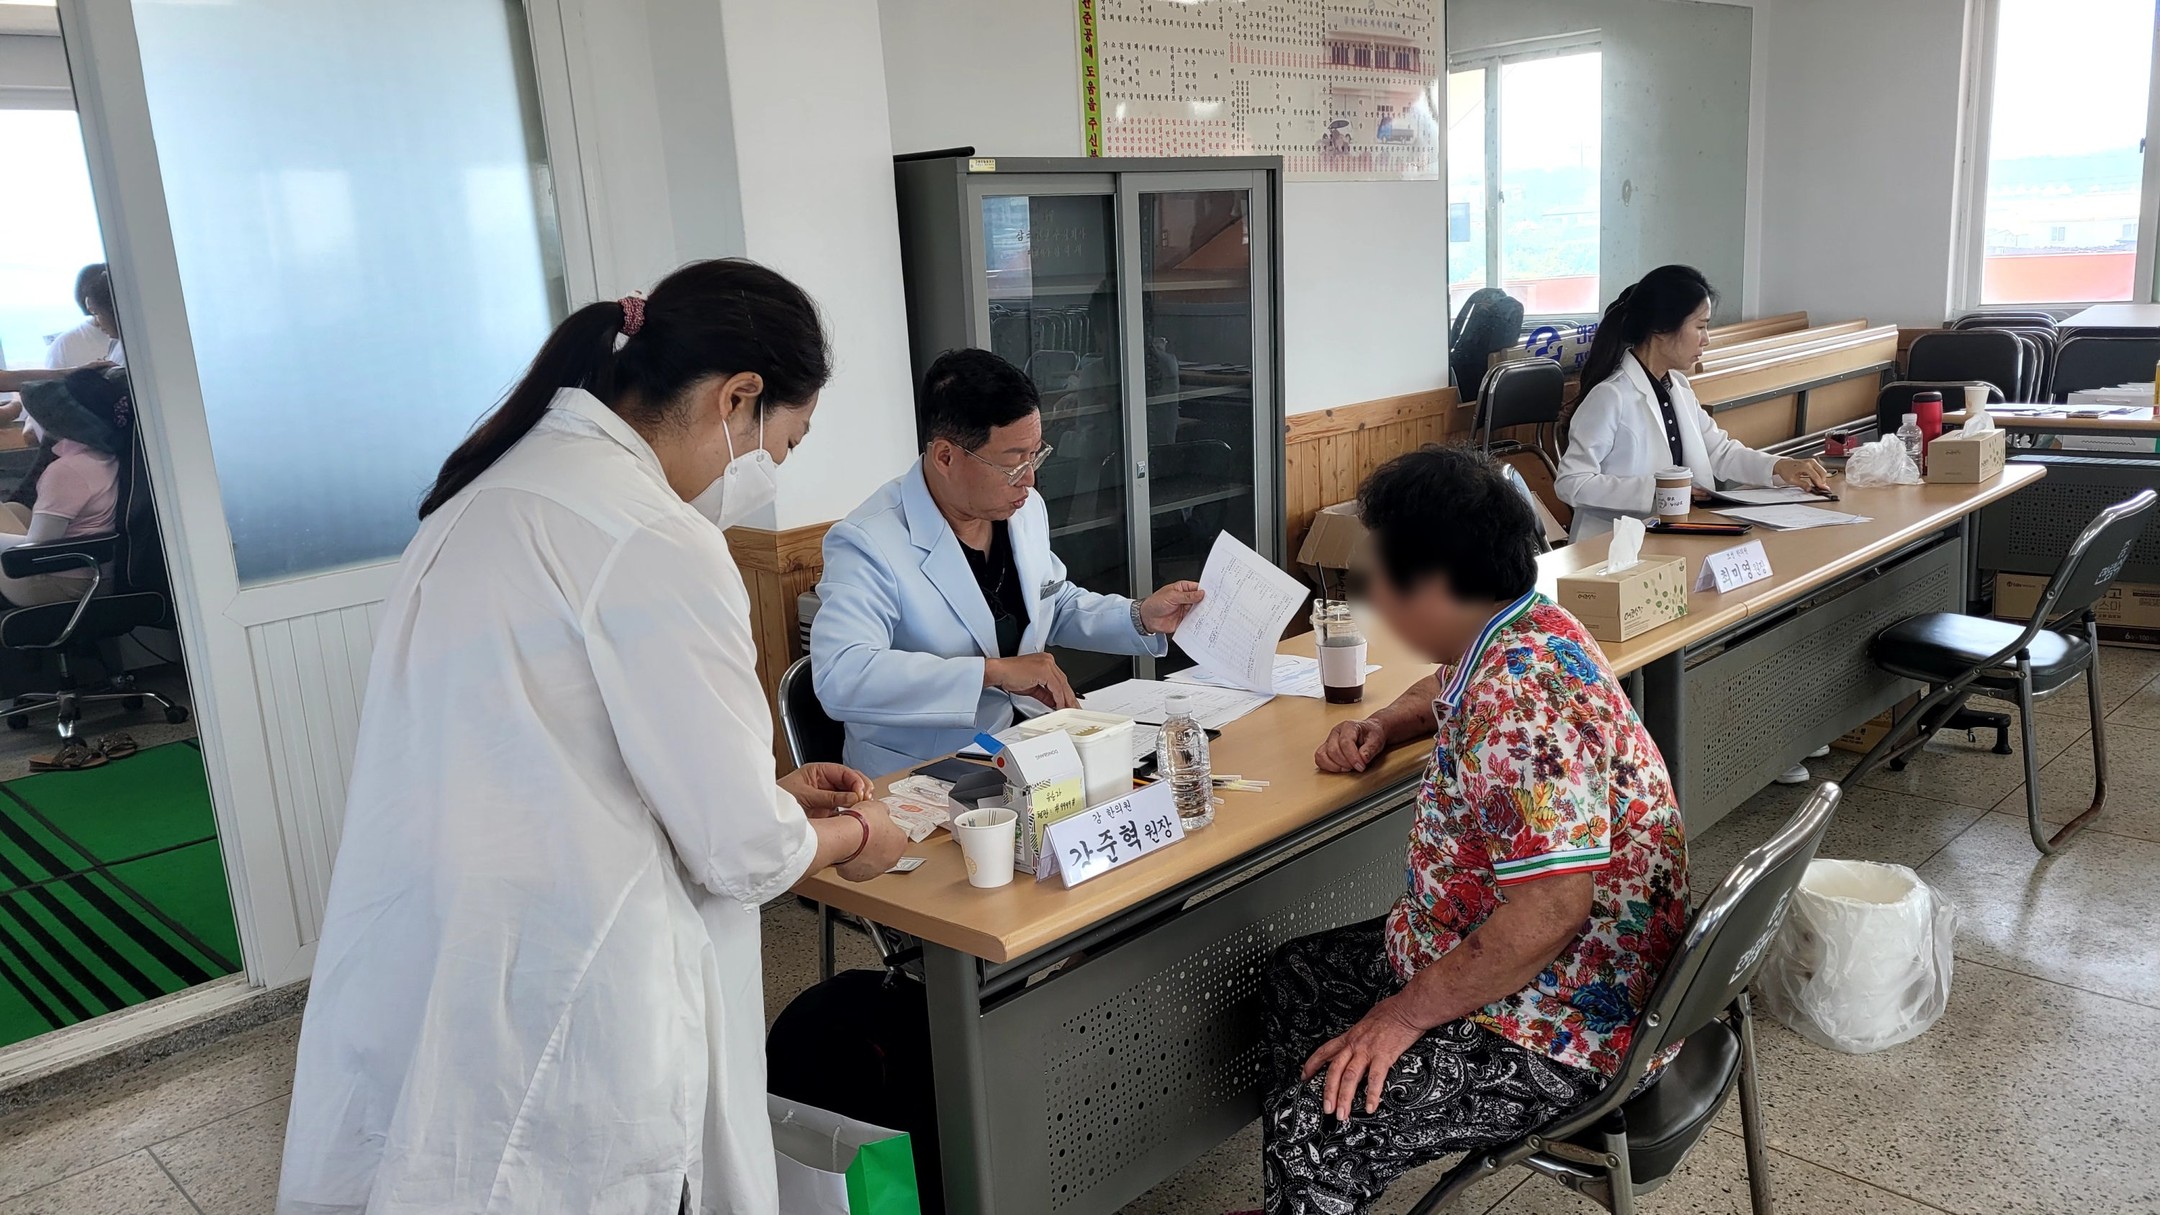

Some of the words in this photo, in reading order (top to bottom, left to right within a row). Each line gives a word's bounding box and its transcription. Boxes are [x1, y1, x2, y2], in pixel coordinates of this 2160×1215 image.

[1720, 559, 1754, 587] 최미영
[1753, 559, 1767, 576] 원장
[1092, 811, 1102, 824] 강
[1106, 799, 1132, 820] 한의원
[1069, 820, 1142, 869] 강준혁
[1144, 815, 1173, 844] 원장
